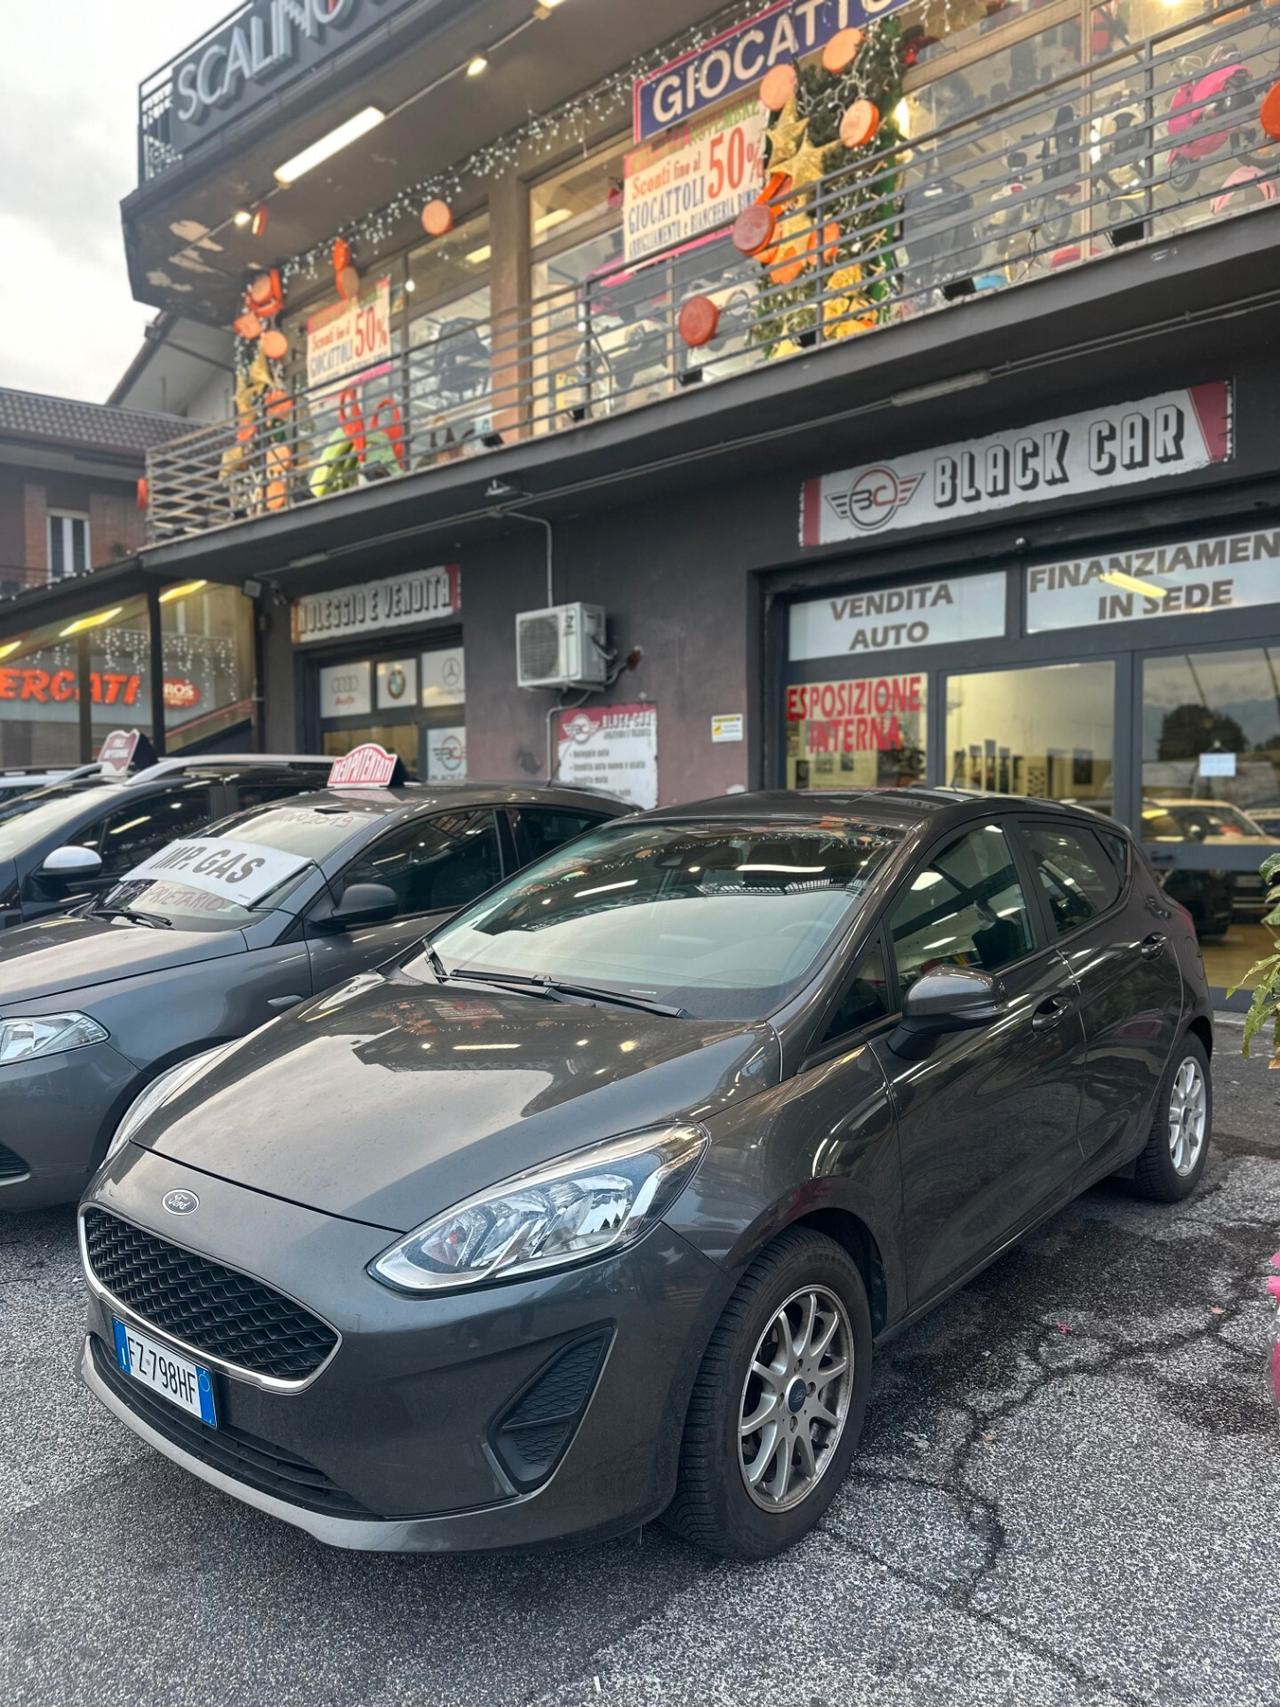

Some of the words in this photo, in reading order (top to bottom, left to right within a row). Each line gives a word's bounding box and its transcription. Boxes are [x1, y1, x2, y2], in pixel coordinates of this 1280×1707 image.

[632, 161, 670, 199] Sconti
[674, 160, 691, 180] fino
[708, 126, 765, 199] 50%
[628, 175, 705, 235] GIOCATTOLI
[355, 304, 388, 358] 50%
[933, 428, 1070, 508] BLACK
[1088, 403, 1184, 475] CAR
[1028, 531, 1280, 593] FINANZIAMEN
[298, 589, 367, 634] NOLEGGIO
[369, 588, 379, 621] E
[384, 573, 451, 619] VENDITA
[830, 583, 953, 621] VENDITA
[1098, 596, 1133, 621] IN
[1143, 579, 1234, 613] SEDE
[848, 621, 930, 651] AUTO
[787, 676, 922, 721] ESPOSIZIONE
[808, 715, 903, 754] INTERNA
[192, 849, 266, 884] GAS
[168, 1193, 190, 1210] Ford
